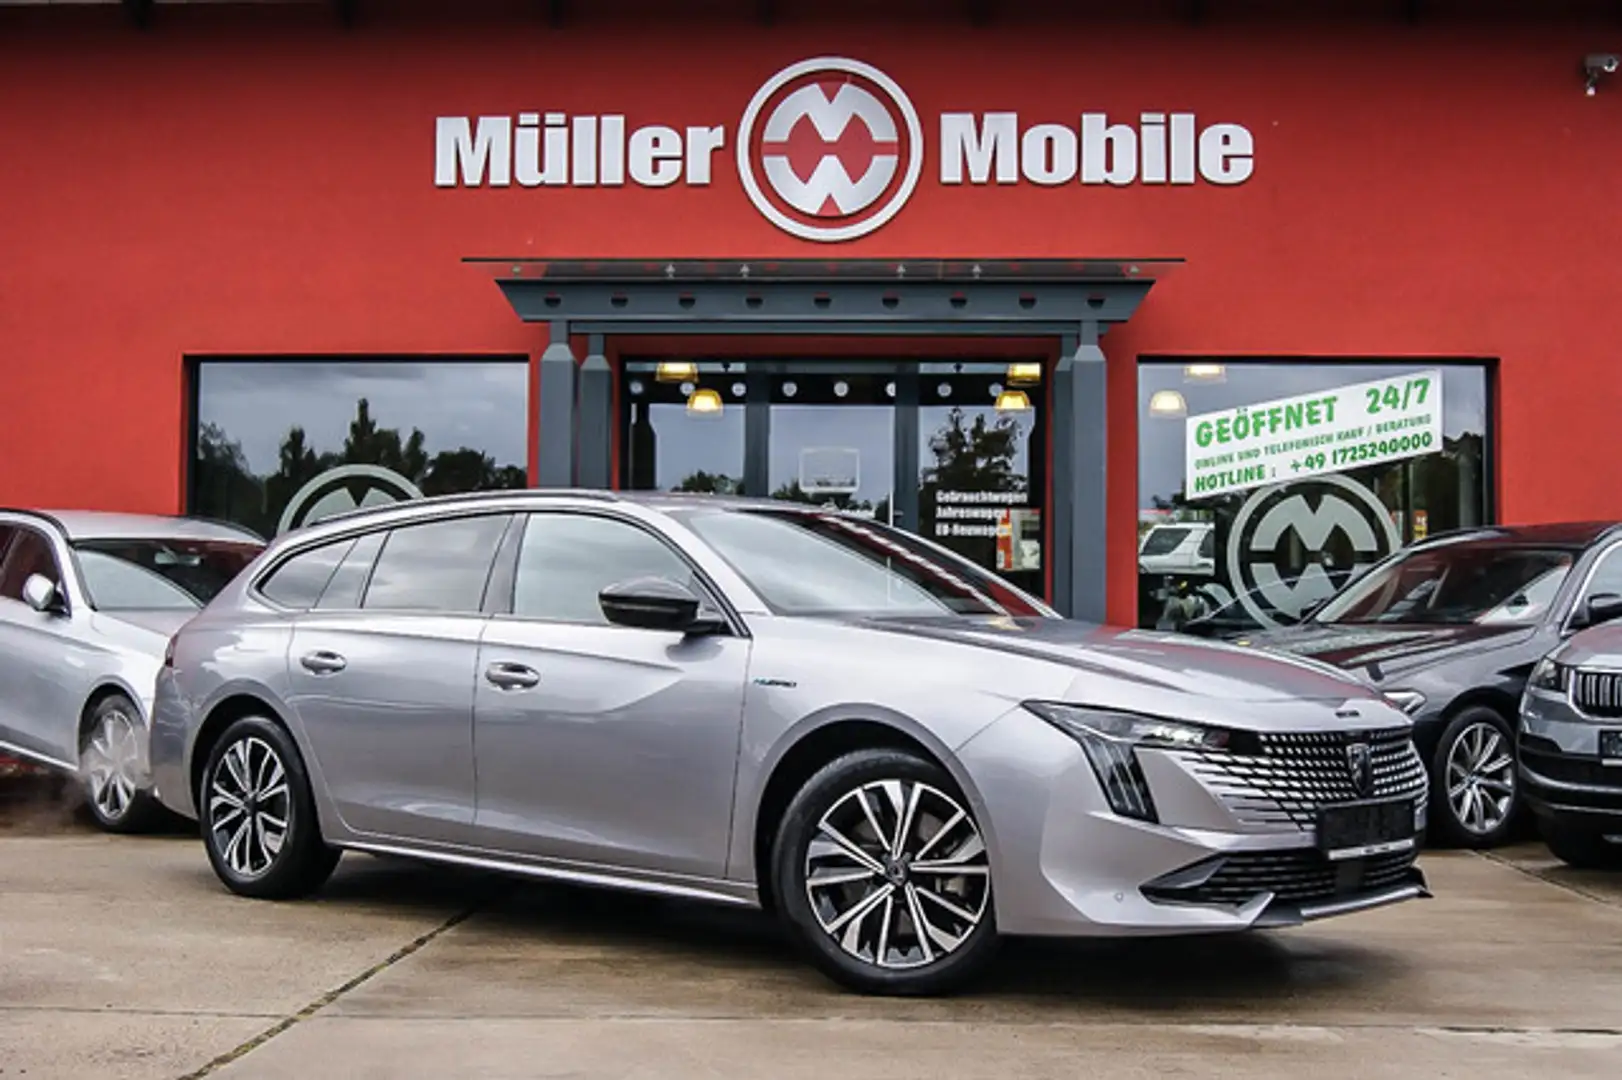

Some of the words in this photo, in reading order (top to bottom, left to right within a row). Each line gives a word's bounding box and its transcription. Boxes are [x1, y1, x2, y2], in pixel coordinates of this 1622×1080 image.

[434, 112, 725, 187] Müller
[940, 111, 1254, 186] Mobile
[1195, 396, 1338, 448] GEÖFFNET
[1366, 378, 1431, 414] 24/7
[1195, 453, 1234, 470] ONLINE
[1238, 448, 1261, 461] UND
[1337, 426, 1364, 441] KAUF
[1376, 413, 1432, 434] BERATUNG
[1195, 464, 1266, 492] HOTLINE
[1290, 451, 1327, 473] +49
